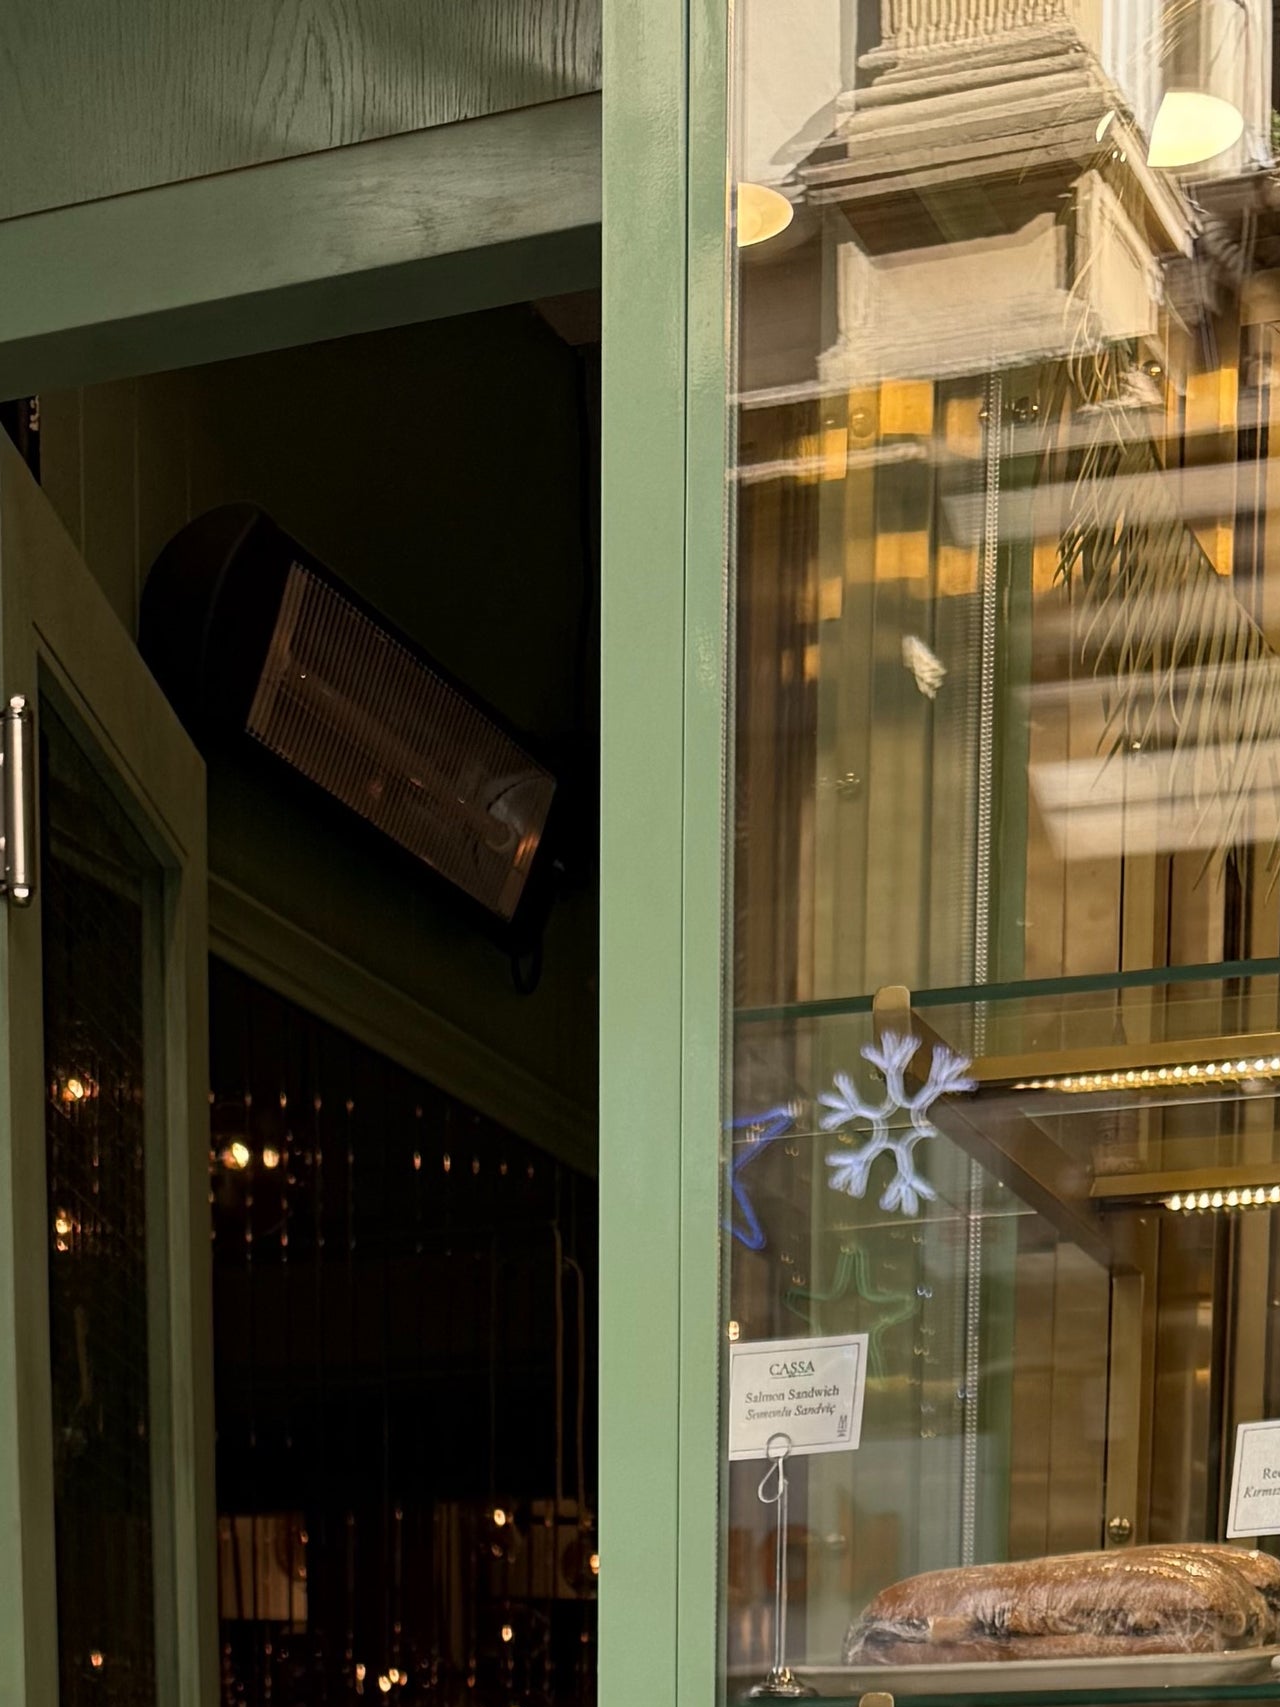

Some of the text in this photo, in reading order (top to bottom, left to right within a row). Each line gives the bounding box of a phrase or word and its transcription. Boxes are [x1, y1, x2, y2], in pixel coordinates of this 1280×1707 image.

[769, 1360, 815, 1378] CASSA
[745, 1385, 839, 1403] Salmon Sandwich
